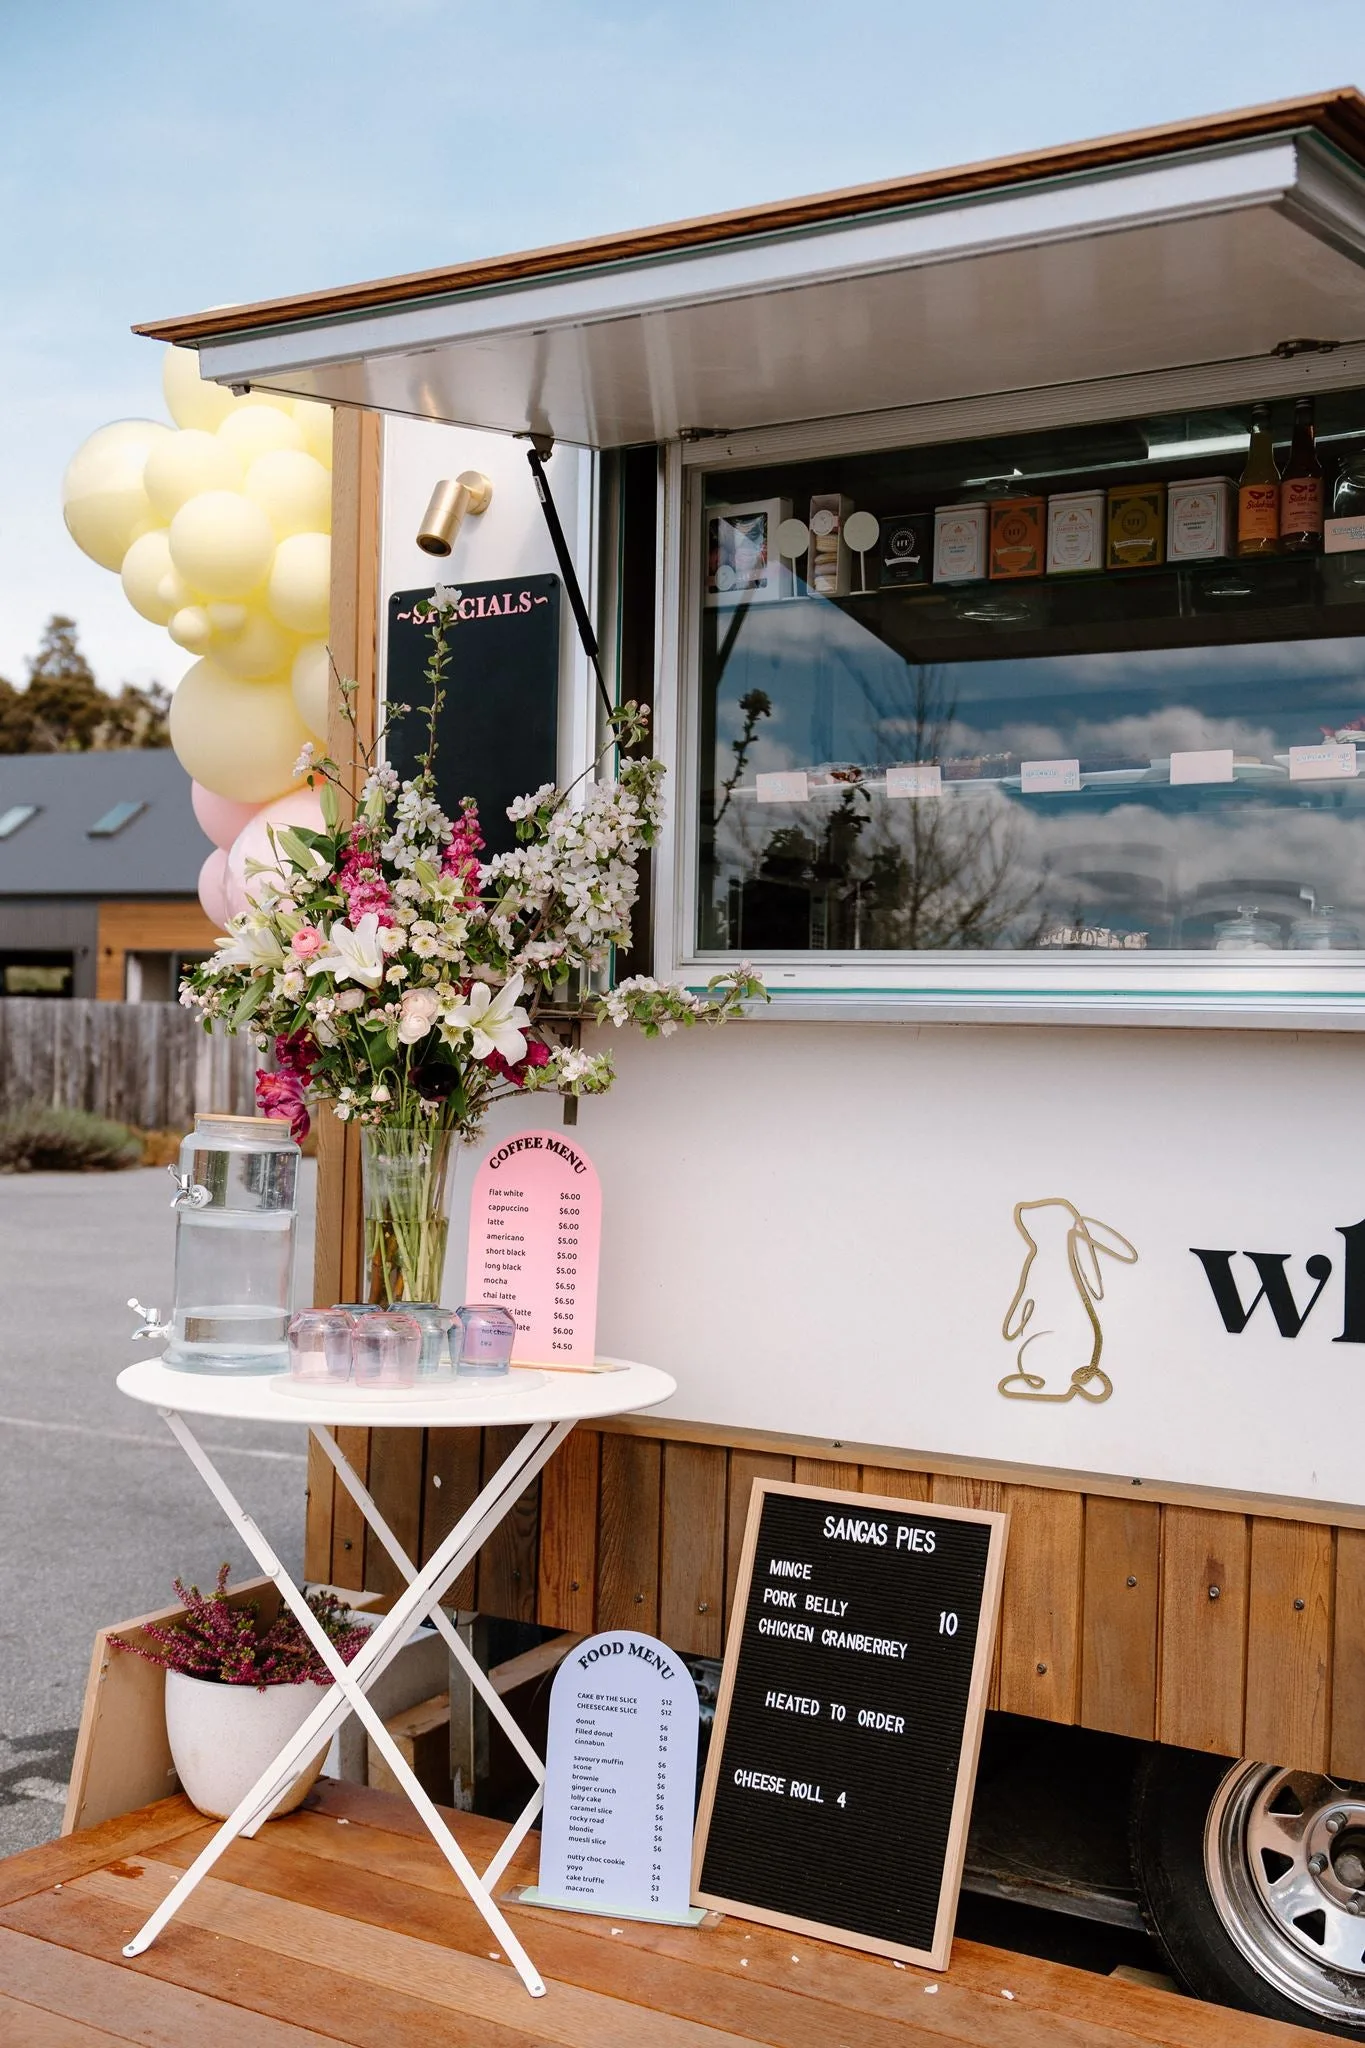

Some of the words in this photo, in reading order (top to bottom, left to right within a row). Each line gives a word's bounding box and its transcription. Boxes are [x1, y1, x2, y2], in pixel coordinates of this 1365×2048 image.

[397, 591, 548, 624] ~SCIALS~
[489, 1137, 543, 1169] COFFEE
[545, 1138, 587, 1174] MENU
[489, 1188, 502, 1196] flat
[560, 1192, 581, 1200] $6.00
[488, 1204, 529, 1212] cappuccino
[559, 1207, 580, 1215] $6.00
[487, 1218, 504, 1226] latte
[558, 1222, 579, 1230] $6.00
[486, 1233, 524, 1242] americano
[558, 1237, 578, 1245] $5.00
[557, 1251, 577, 1260] $5.00
[485, 1262, 501, 1271] long
[502, 1263, 522, 1271] black
[556, 1266, 577, 1275] $5.00
[555, 1282, 576, 1291] $6.50
[483, 1291, 498, 1299] chai
[499, 1292, 516, 1300] latte
[554, 1297, 575, 1305] $6.50
[514, 1308, 532, 1316] latte
[553, 1312, 574, 1320] $6.50
[553, 1326, 573, 1335] $6.00
[552, 1341, 573, 1350] $4.50
[823, 1516, 888, 1546] SANGAS
[896, 1526, 936, 1554] PIES
[769, 1559, 813, 1580] MINCE
[763, 1588, 797, 1608] PORK
[805, 1594, 848, 1617] BELLY
[939, 1611, 958, 1636] 10
[758, 1618, 814, 1643] CHICKEN
[821, 1629, 908, 1660] CRANBERREY
[577, 1641, 624, 1670] FOOD
[628, 1643, 675, 1681] MENU
[577, 1692, 593, 1700] CAKE
[619, 1696, 637, 1704] SLICE
[577, 1703, 618, 1712] CHEESECAKE
[765, 1691, 820, 1716] HEATED
[830, 1703, 846, 1722] TO
[858, 1709, 905, 1734] ORDER
[576, 1718, 595, 1726] donut
[593, 1730, 613, 1738] donut
[659, 1734, 668, 1742] $8
[574, 1739, 605, 1747] cinnabun
[574, 1756, 600, 1764] savoury
[601, 1758, 624, 1766] muffin
[572, 1773, 599, 1782] brownie
[657, 1772, 666, 1780] $6
[571, 1784, 593, 1792] ginger
[734, 1769, 786, 1794] CHEESE
[790, 1781, 824, 1803] ROLL
[837, 1792, 846, 1808] 4
[571, 1794, 585, 1802] lolly
[570, 1805, 597, 1813] caramel
[569, 1815, 588, 1823] rocky
[569, 1825, 594, 1833] blondie
[653, 1845, 662, 1853] $6
[567, 1854, 586, 1862] nutty
[603, 1858, 625, 1866] cookie
[652, 1863, 661, 1871] $4
[582, 1876, 605, 1884] truffle
[565, 1885, 594, 1893] macaron
